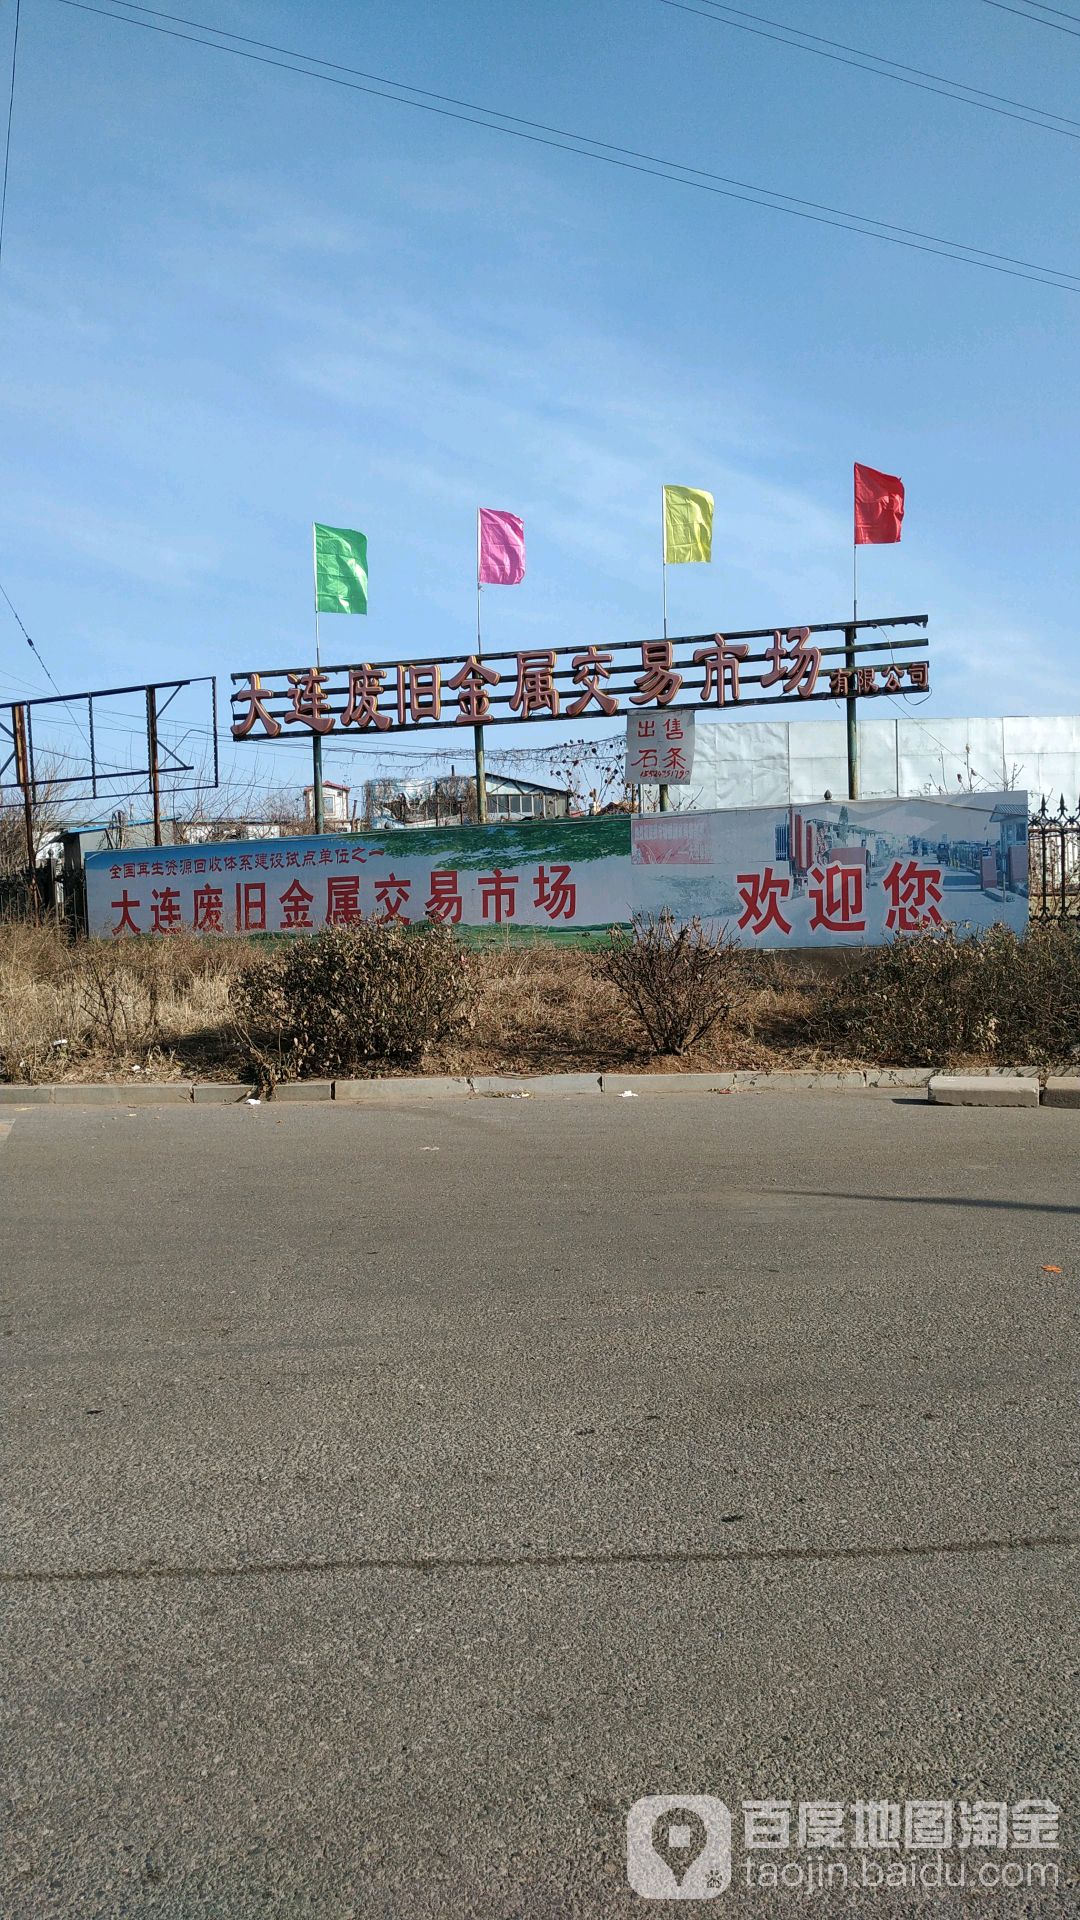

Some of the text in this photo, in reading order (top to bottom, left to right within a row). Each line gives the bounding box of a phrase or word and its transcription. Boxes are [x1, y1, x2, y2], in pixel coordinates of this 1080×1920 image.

[231, 626, 821, 737] 大连废旧金属交易市场
[829, 663, 929, 695] 有限公司
[637, 718, 684, 740] 出售
[631, 747, 687, 770] 石条
[109, 846, 385, 879] 全国再生资源回收体系建设试点单位之一
[111, 865, 576, 936] 大连废旧金属交易市场
[736, 861, 943, 935] 欢迎您
